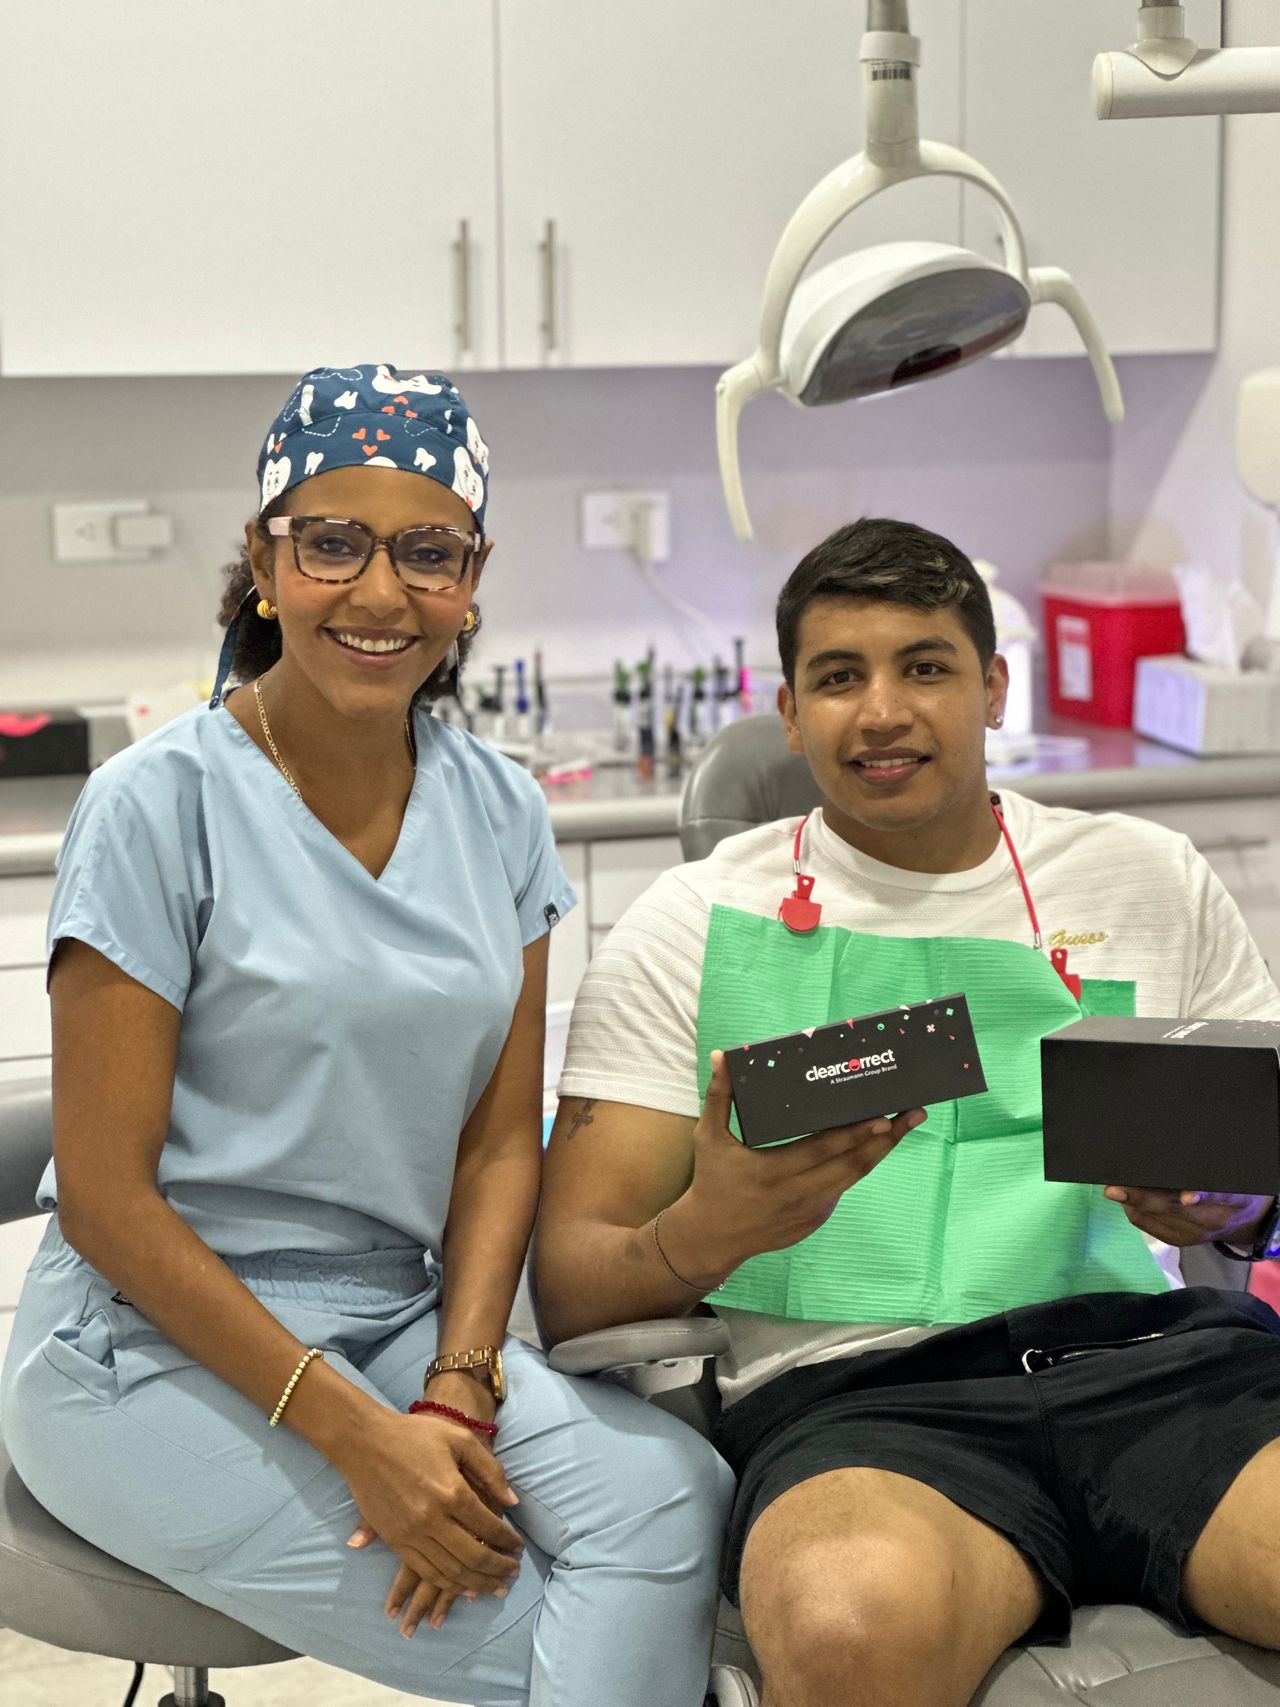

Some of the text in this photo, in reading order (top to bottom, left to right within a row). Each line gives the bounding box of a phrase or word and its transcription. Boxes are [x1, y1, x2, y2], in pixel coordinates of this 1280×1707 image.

[805, 1049, 895, 1082] clearcorrect
[864, 1068, 881, 1076] Group
[881, 1064, 898, 1072] Brand
